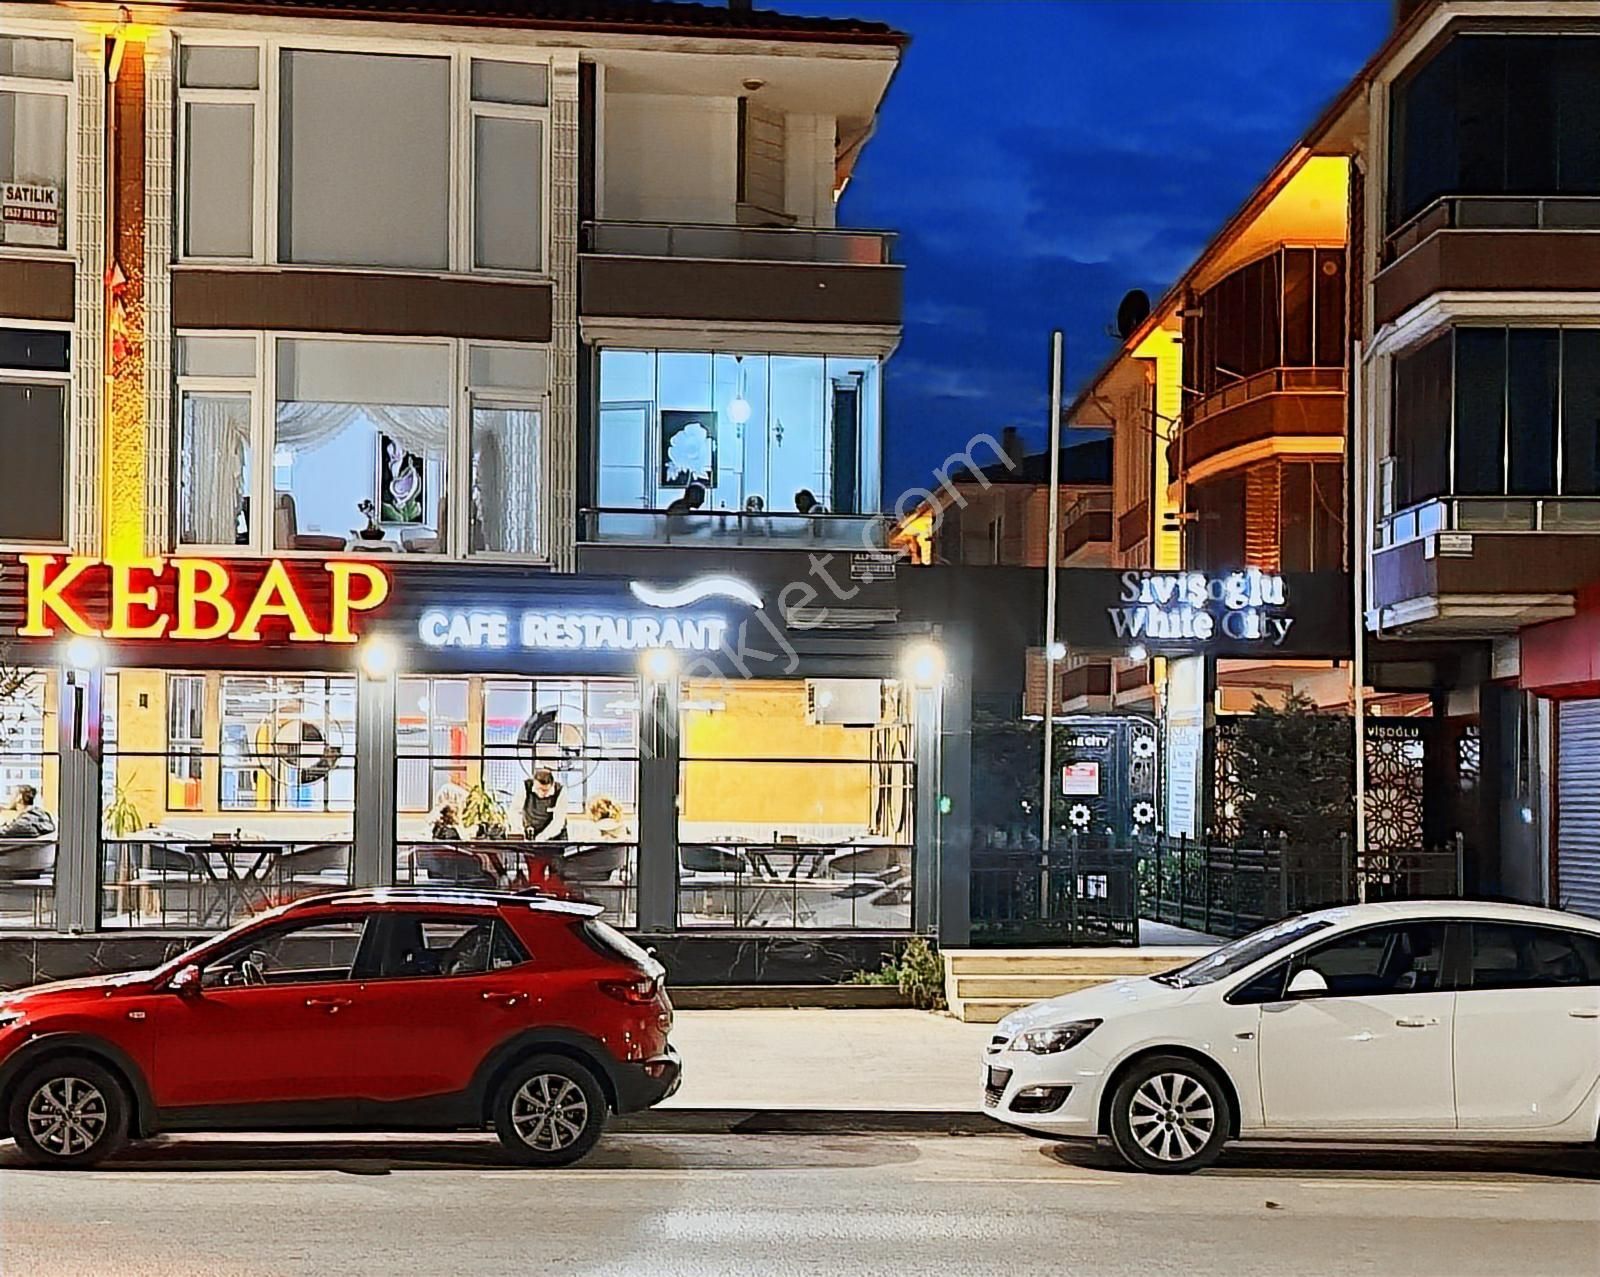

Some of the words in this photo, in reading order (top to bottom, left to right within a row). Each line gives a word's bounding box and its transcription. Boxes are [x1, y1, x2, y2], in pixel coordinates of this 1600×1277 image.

[6, 186, 55, 203] SATILIK
[17, 554, 389, 643] KEBAP
[419, 612, 508, 648] CAFE
[521, 612, 728, 651] RESTAURANT
[1107, 604, 1214, 640] White
[1222, 608, 1294, 646] City
